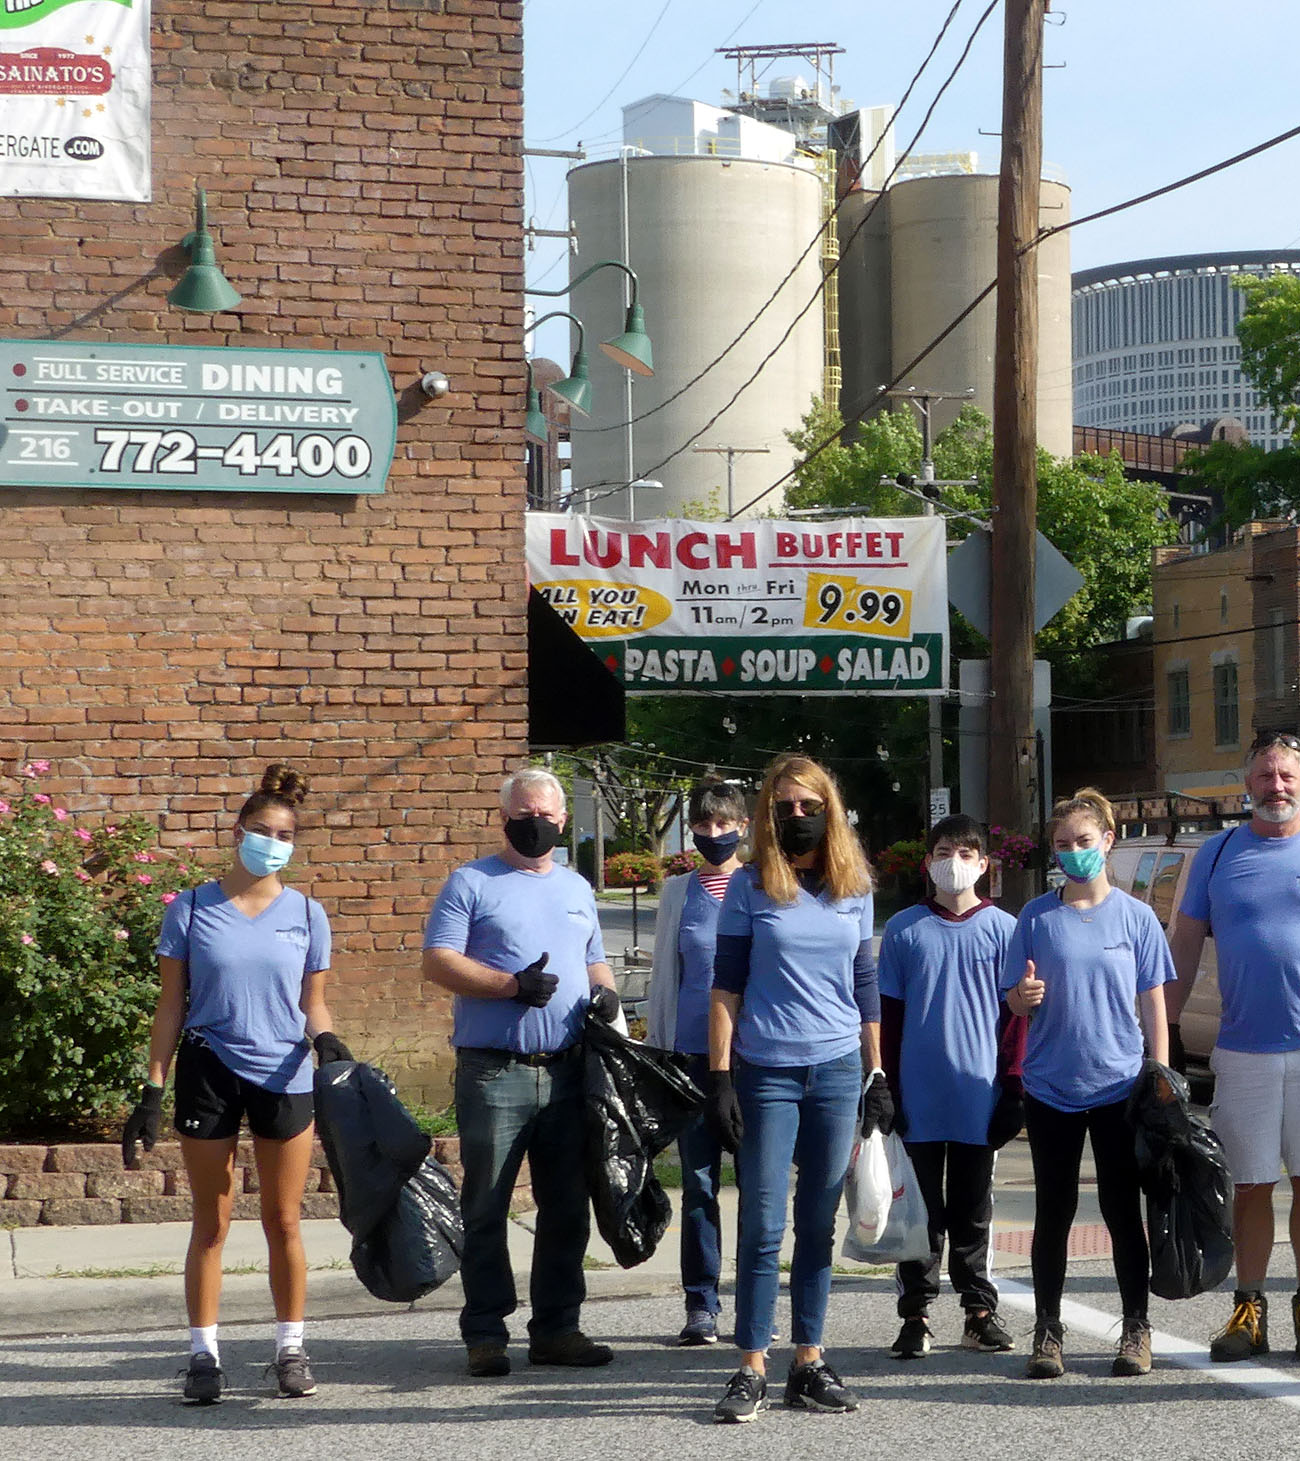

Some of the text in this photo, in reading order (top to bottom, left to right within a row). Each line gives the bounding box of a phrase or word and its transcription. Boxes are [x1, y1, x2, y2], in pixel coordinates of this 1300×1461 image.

[0, 66, 104, 82] SAINATO'S
[38, 363, 343, 394] FULL SERVICE DINING
[33, 398, 182, 418] TAKE-OUT
[219, 404, 360, 423] DELIVERY
[20, 427, 372, 479] 216 772-4400
[550, 529, 904, 570] LUNCH BUFFET
[590, 589, 636, 604] YOU
[682, 580, 794, 594] Mon thru Fri
[588, 606, 645, 625] EAT!
[817, 583, 902, 626] 9.99
[624, 646, 930, 682] PASTA SOUP SALAD
[930, 804, 946, 815] 25
